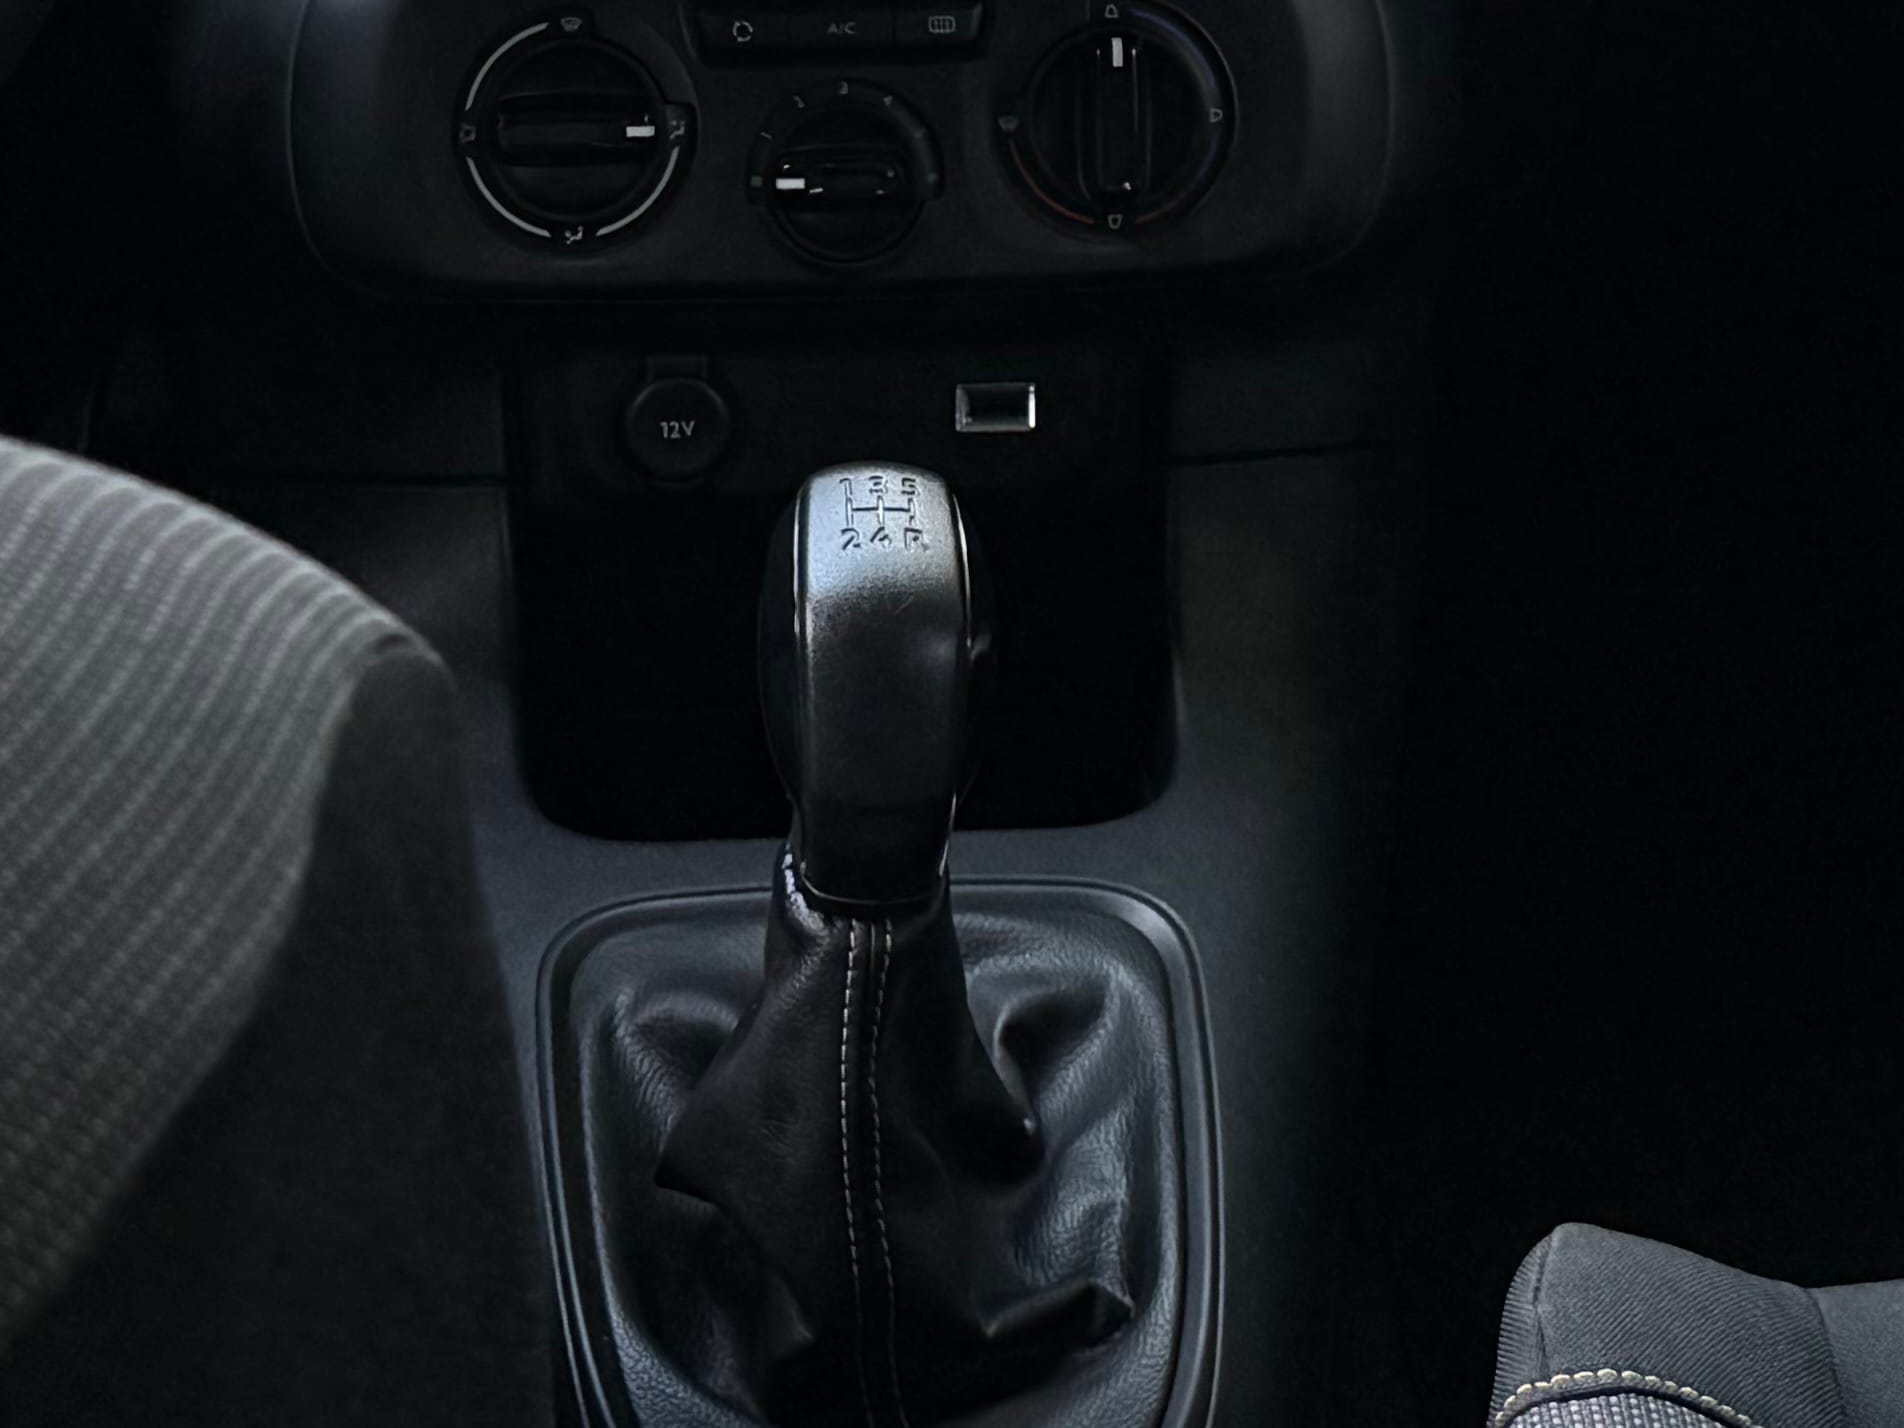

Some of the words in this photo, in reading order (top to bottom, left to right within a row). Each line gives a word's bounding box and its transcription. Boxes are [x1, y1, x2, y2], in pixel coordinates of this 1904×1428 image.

[826, 20, 857, 35] A/C
[660, 420, 696, 439] 12V
[839, 477, 853, 496] 1
[868, 475, 888, 494] 3
[901, 477, 919, 496] 5
[840, 527, 862, 550] 2
[870, 526, 892, 549] 4
[904, 527, 929, 551] R
